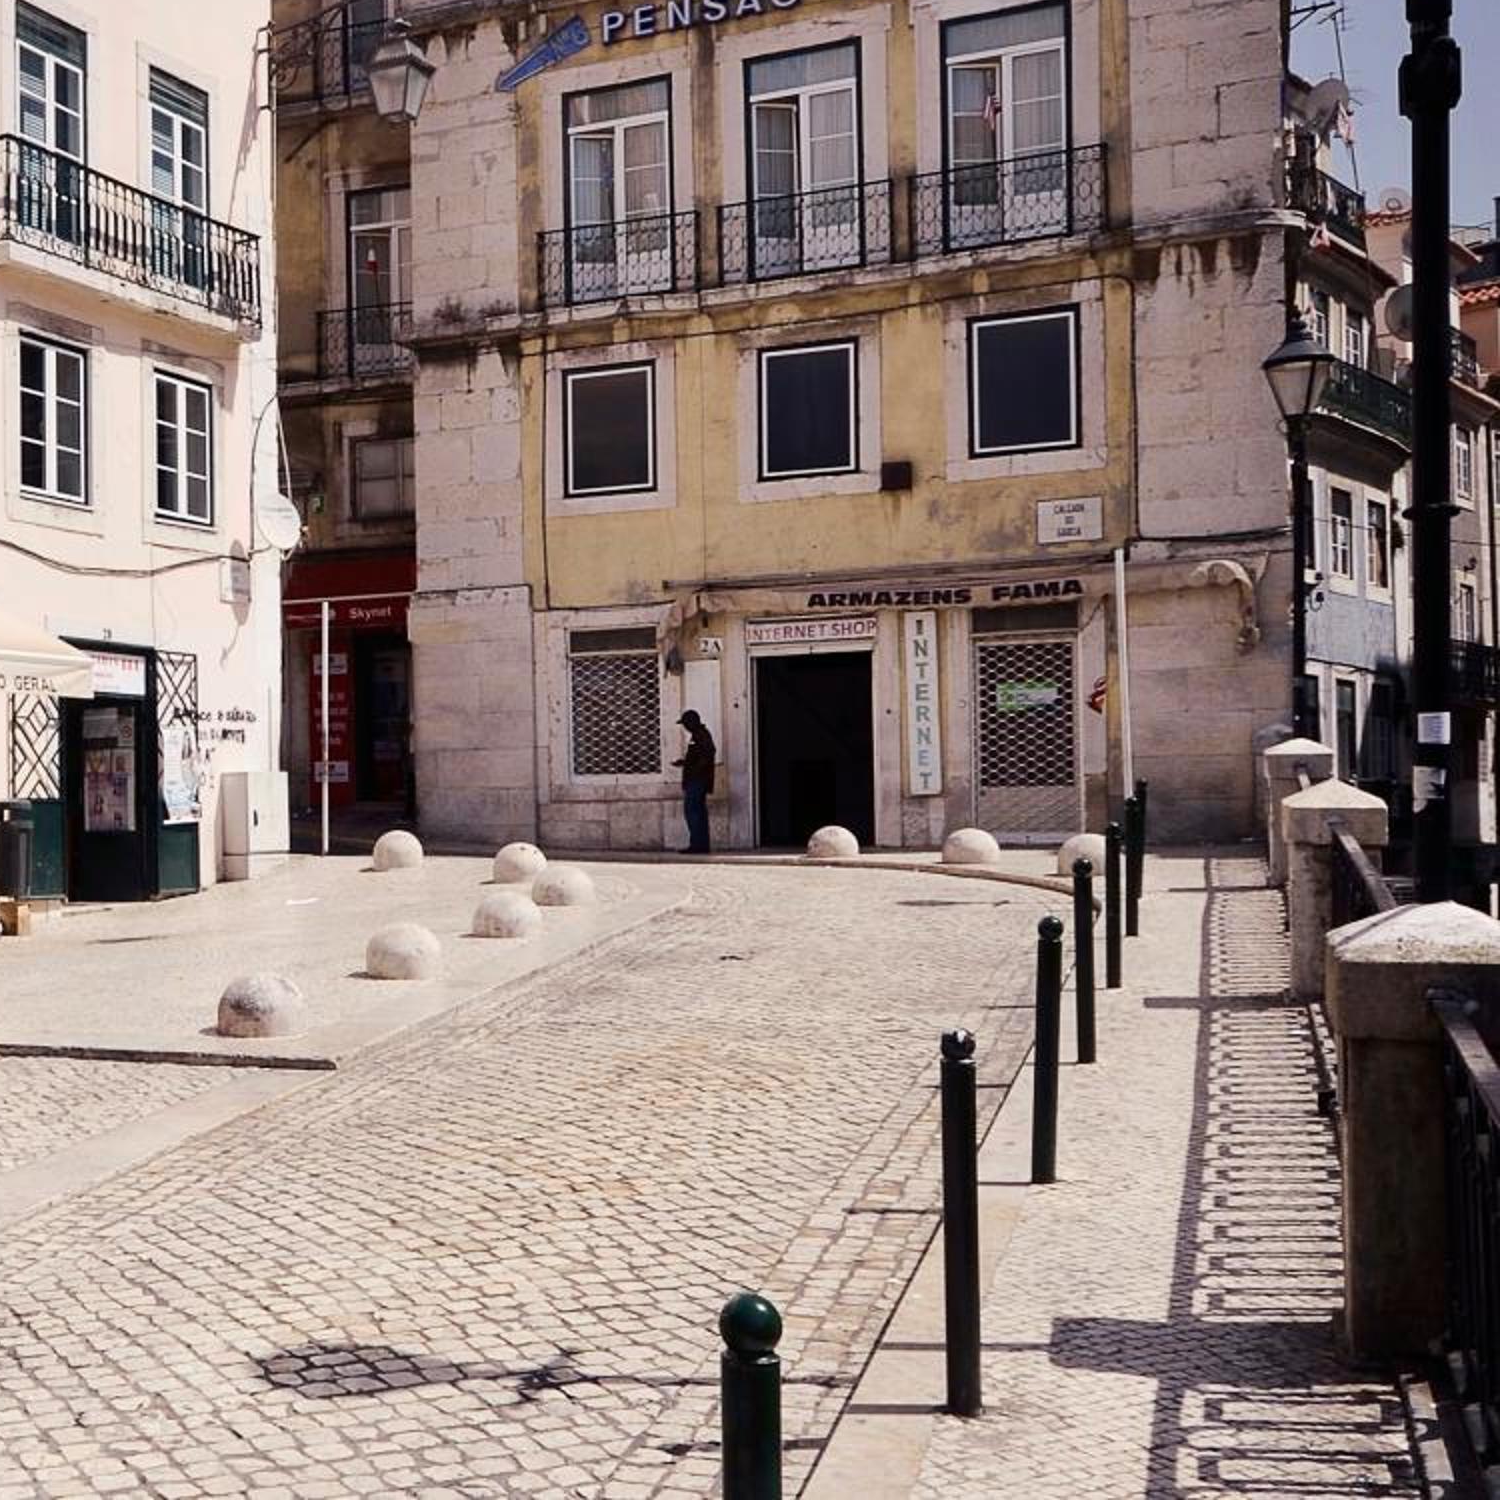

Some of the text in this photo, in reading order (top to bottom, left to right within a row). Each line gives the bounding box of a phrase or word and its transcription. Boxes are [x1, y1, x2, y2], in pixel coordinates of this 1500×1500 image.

[807, 579, 1084, 608] ARMAZENS FAMA
[349, 606, 392, 622] Skynet
[747, 620, 877, 641] INTERNET SHOP
[700, 640, 722, 653] 2A
[13, 675, 58, 693] GERAL
[913, 619, 933, 789] INTERNET
